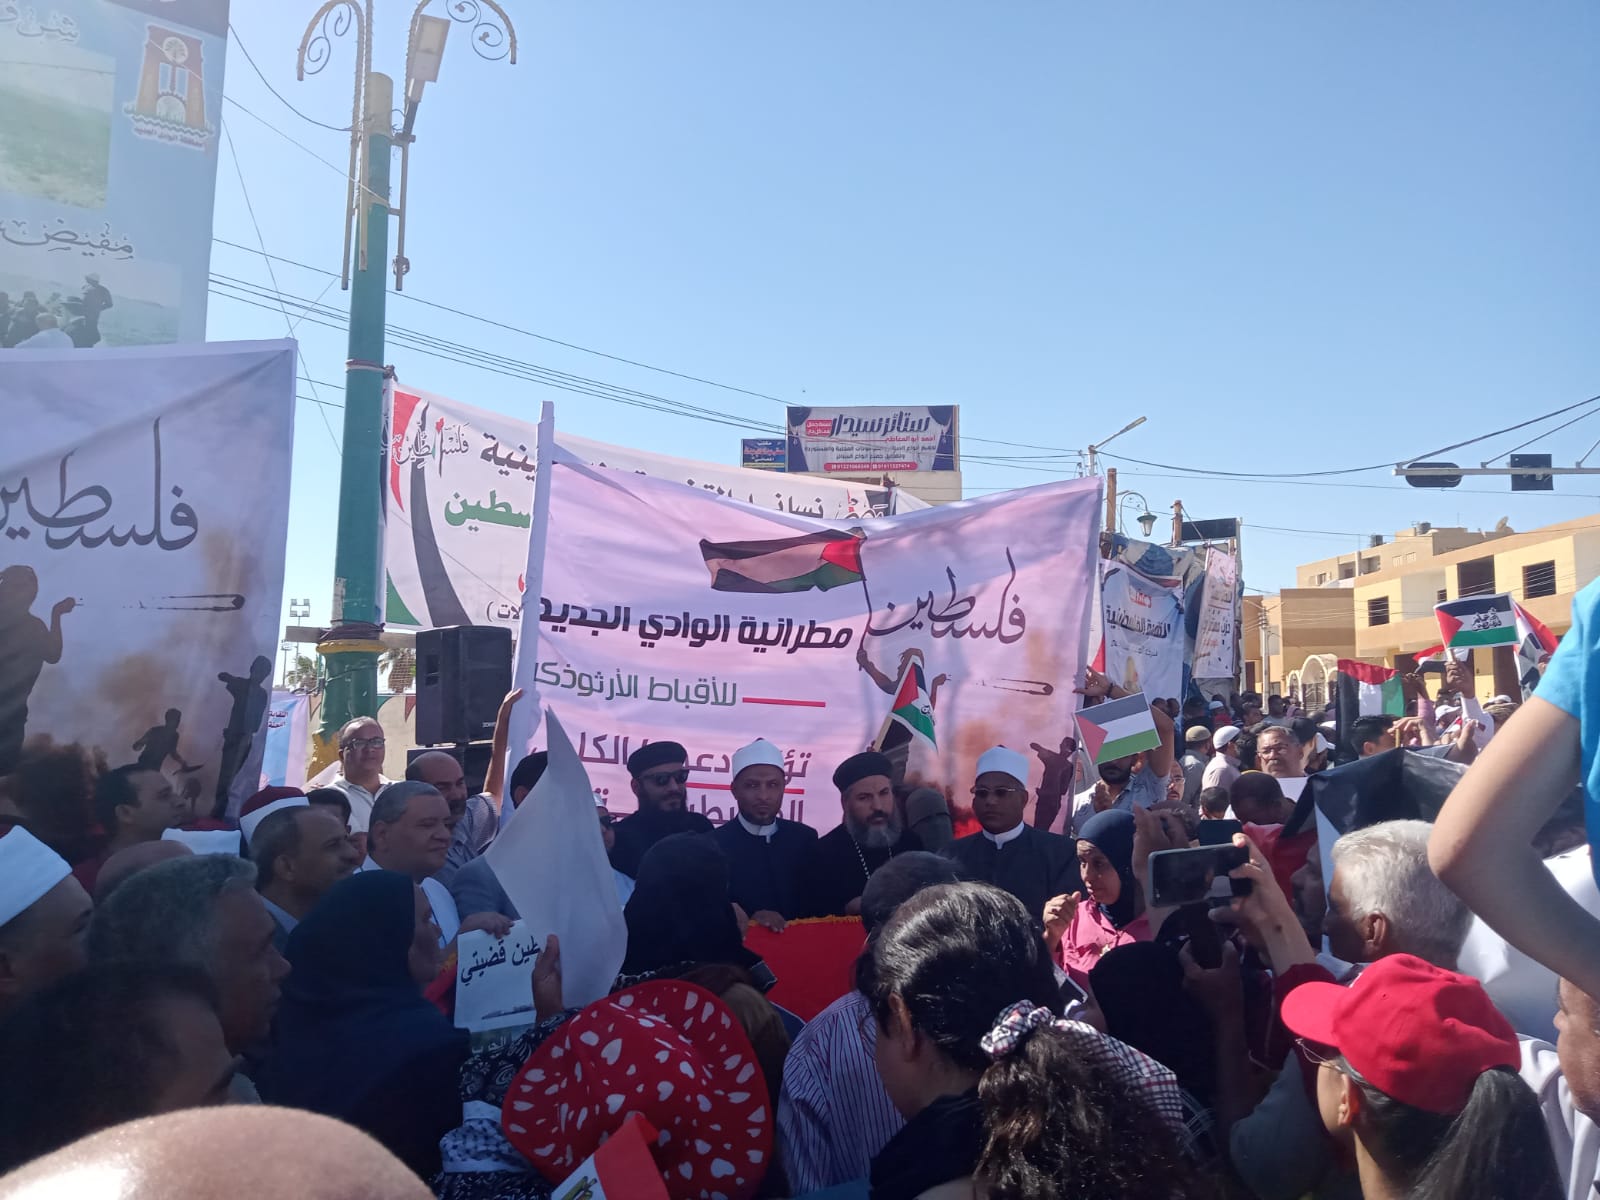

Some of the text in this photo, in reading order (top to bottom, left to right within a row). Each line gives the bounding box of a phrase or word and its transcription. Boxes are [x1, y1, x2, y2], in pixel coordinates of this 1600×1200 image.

[0, 415, 199, 551] فلسطي
[638, 611, 731, 648] الوادي
[738, 615, 853, 655] مطرانية
[534, 661, 738, 709] للأقباط الأرثوذك
